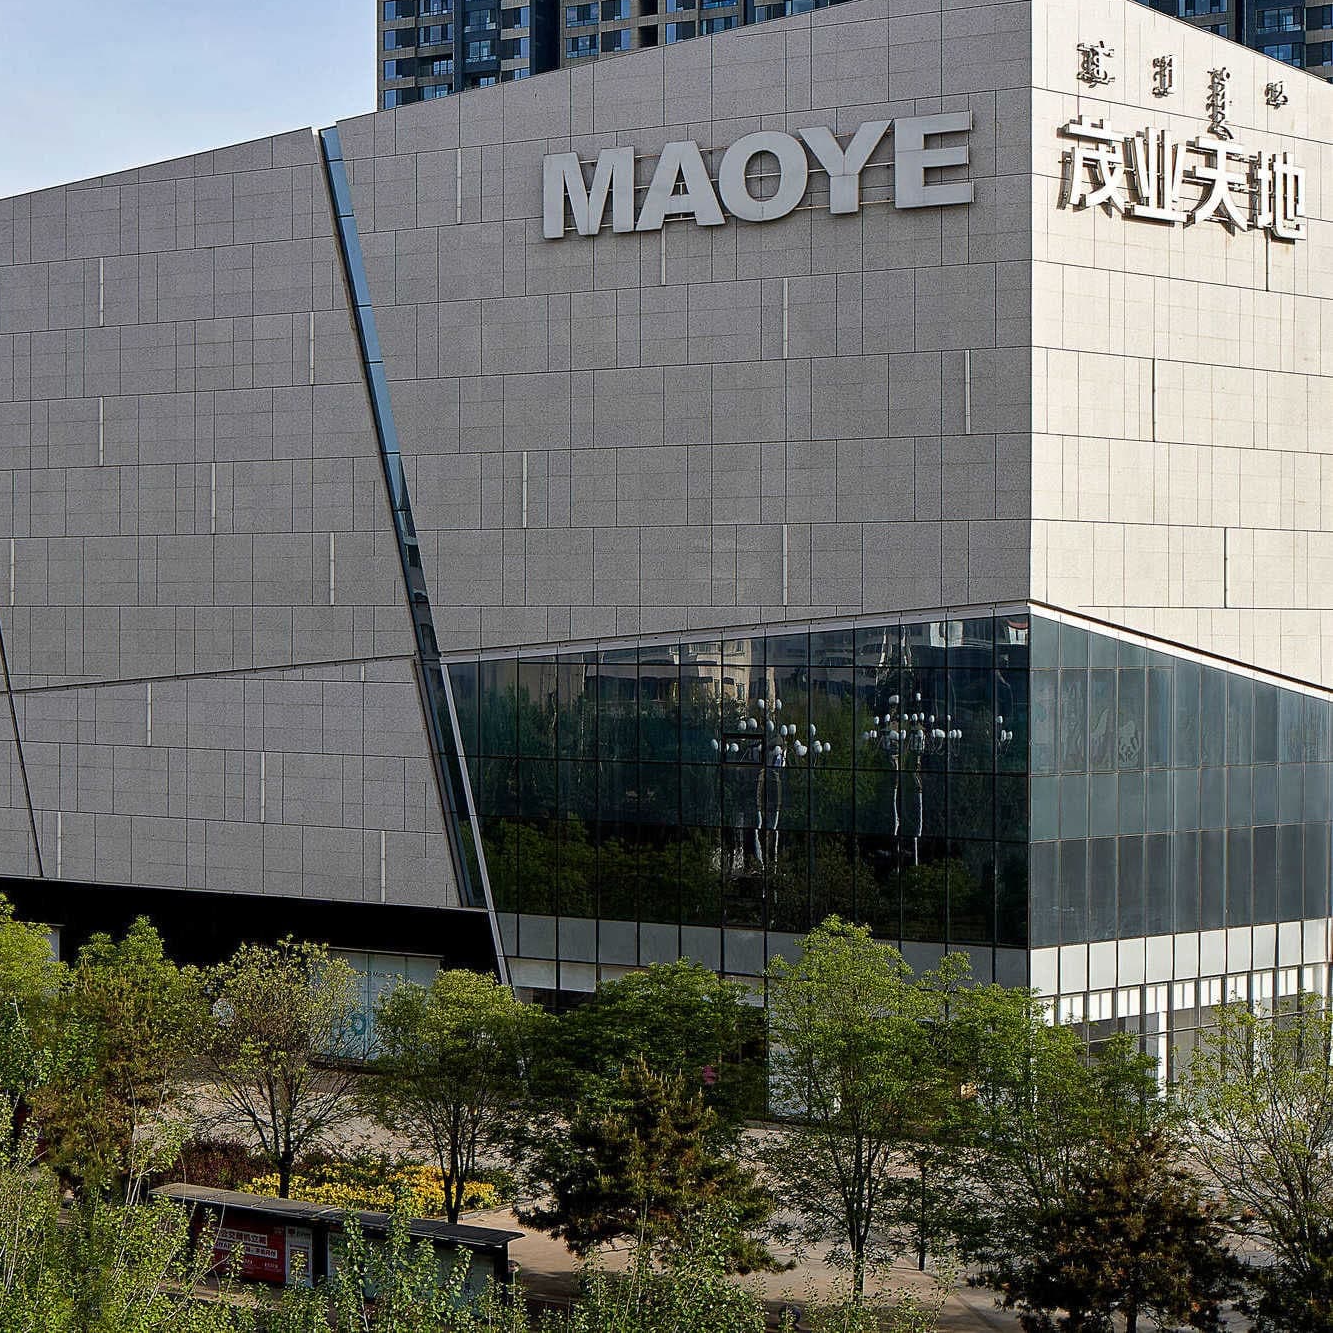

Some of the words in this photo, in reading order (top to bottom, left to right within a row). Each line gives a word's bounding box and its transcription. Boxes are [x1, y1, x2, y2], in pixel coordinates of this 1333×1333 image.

[542, 109, 974, 240] MAOYE
[1057, 114, 1307, 243] 茂业天地
